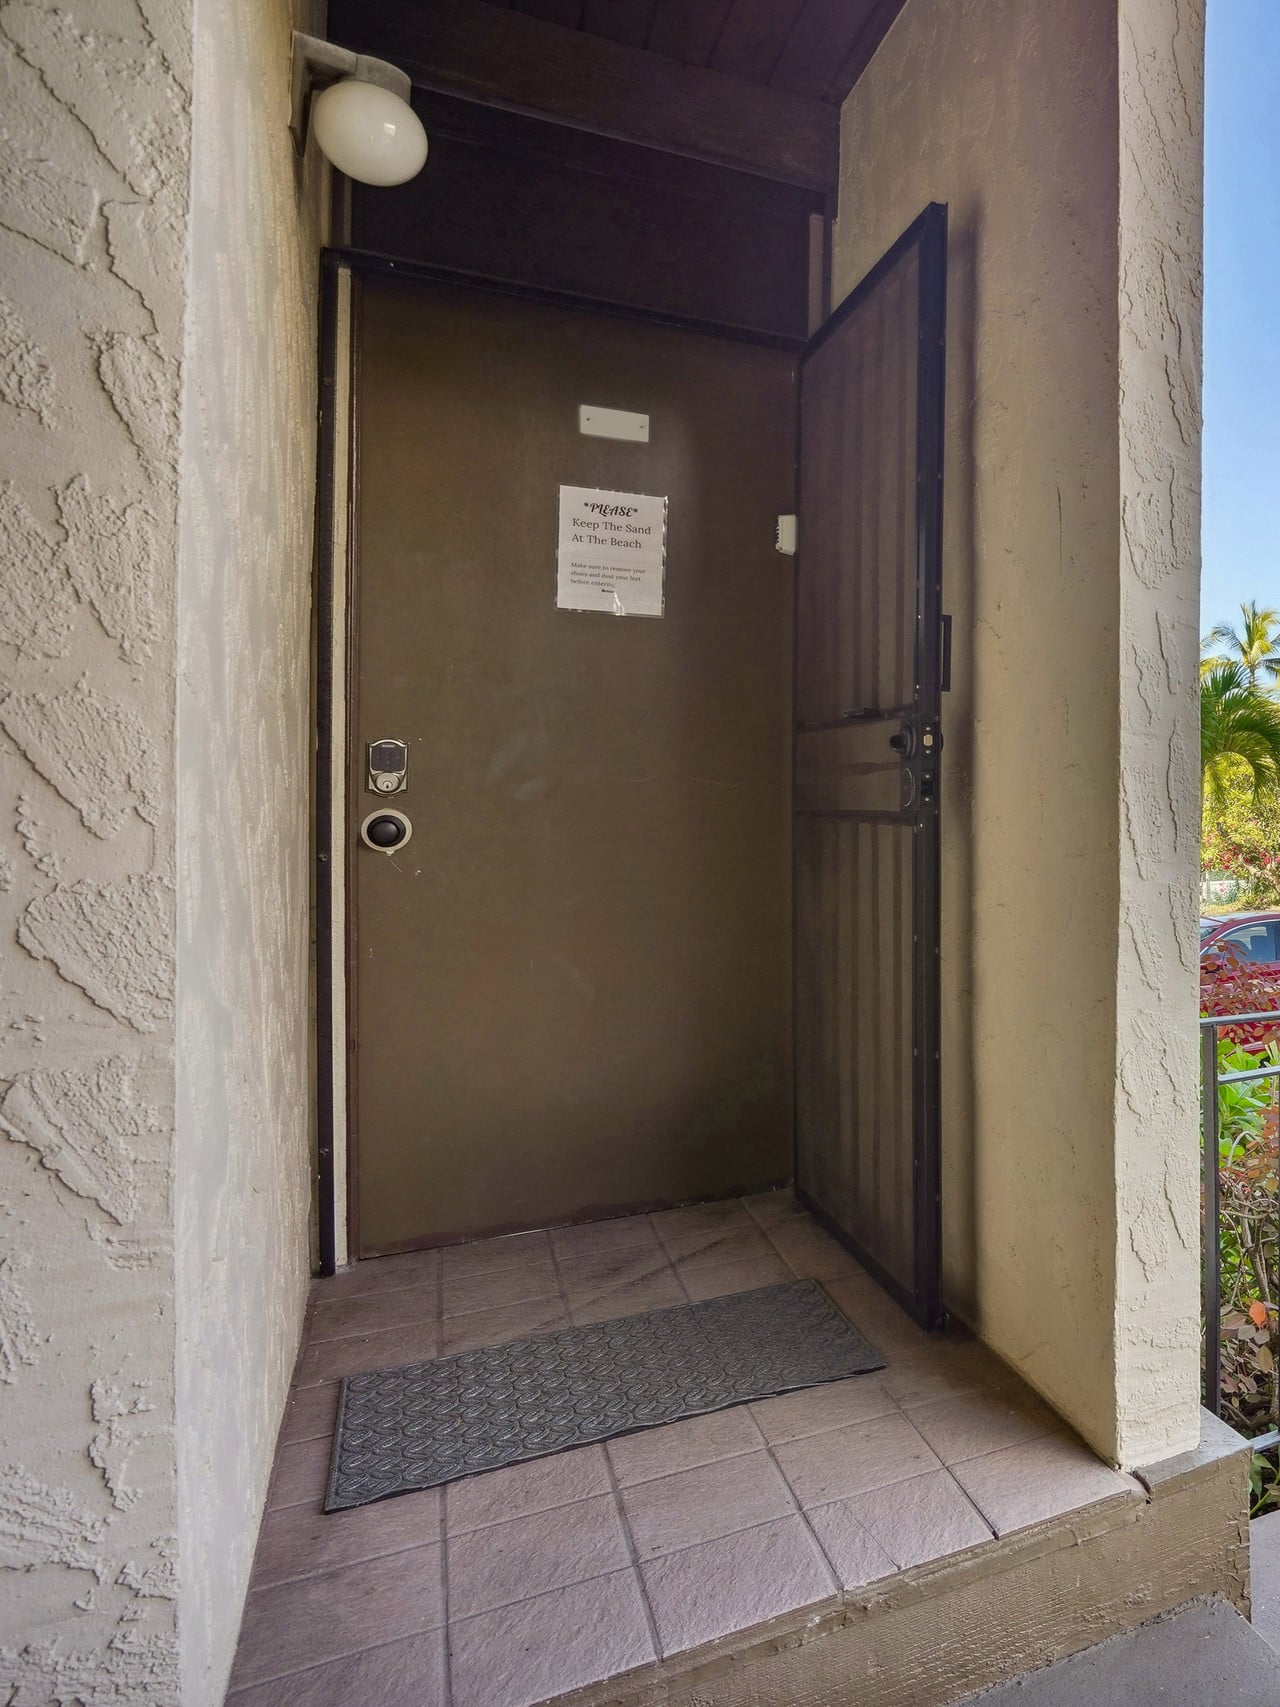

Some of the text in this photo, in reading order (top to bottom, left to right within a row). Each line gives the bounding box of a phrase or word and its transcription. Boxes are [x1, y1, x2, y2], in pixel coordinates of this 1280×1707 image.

[572, 518, 651, 535] Keep The Sand
[571, 533, 641, 549] At The Beach
